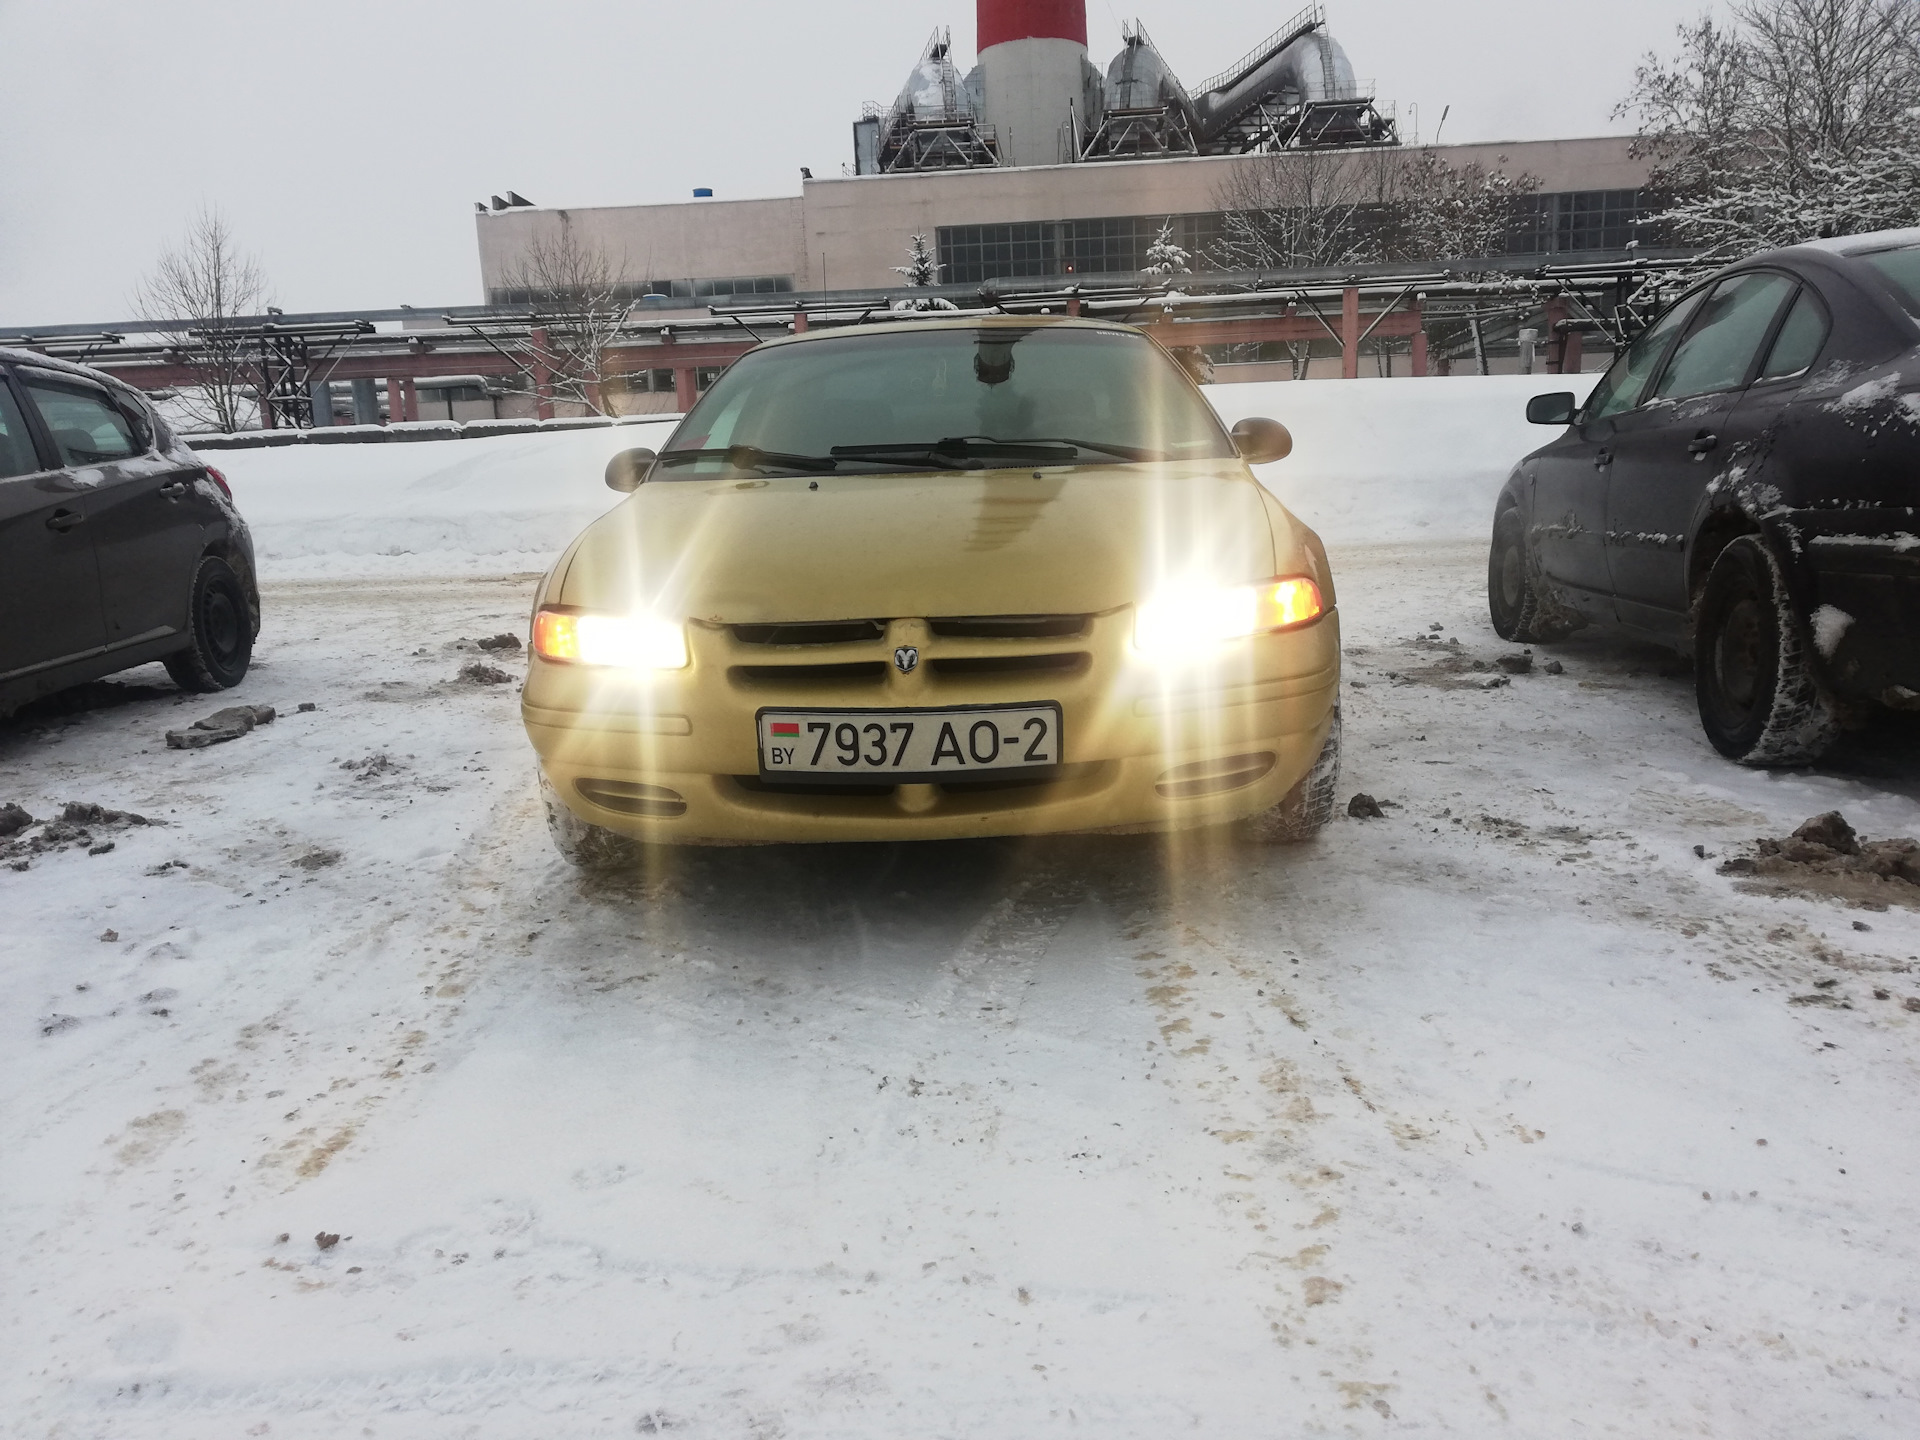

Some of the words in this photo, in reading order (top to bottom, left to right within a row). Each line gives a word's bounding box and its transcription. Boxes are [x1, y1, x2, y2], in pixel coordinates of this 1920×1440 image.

[771, 747, 795, 765] BY
[807, 722, 914, 766] 7937
[931, 717, 1048, 766] AO-2
